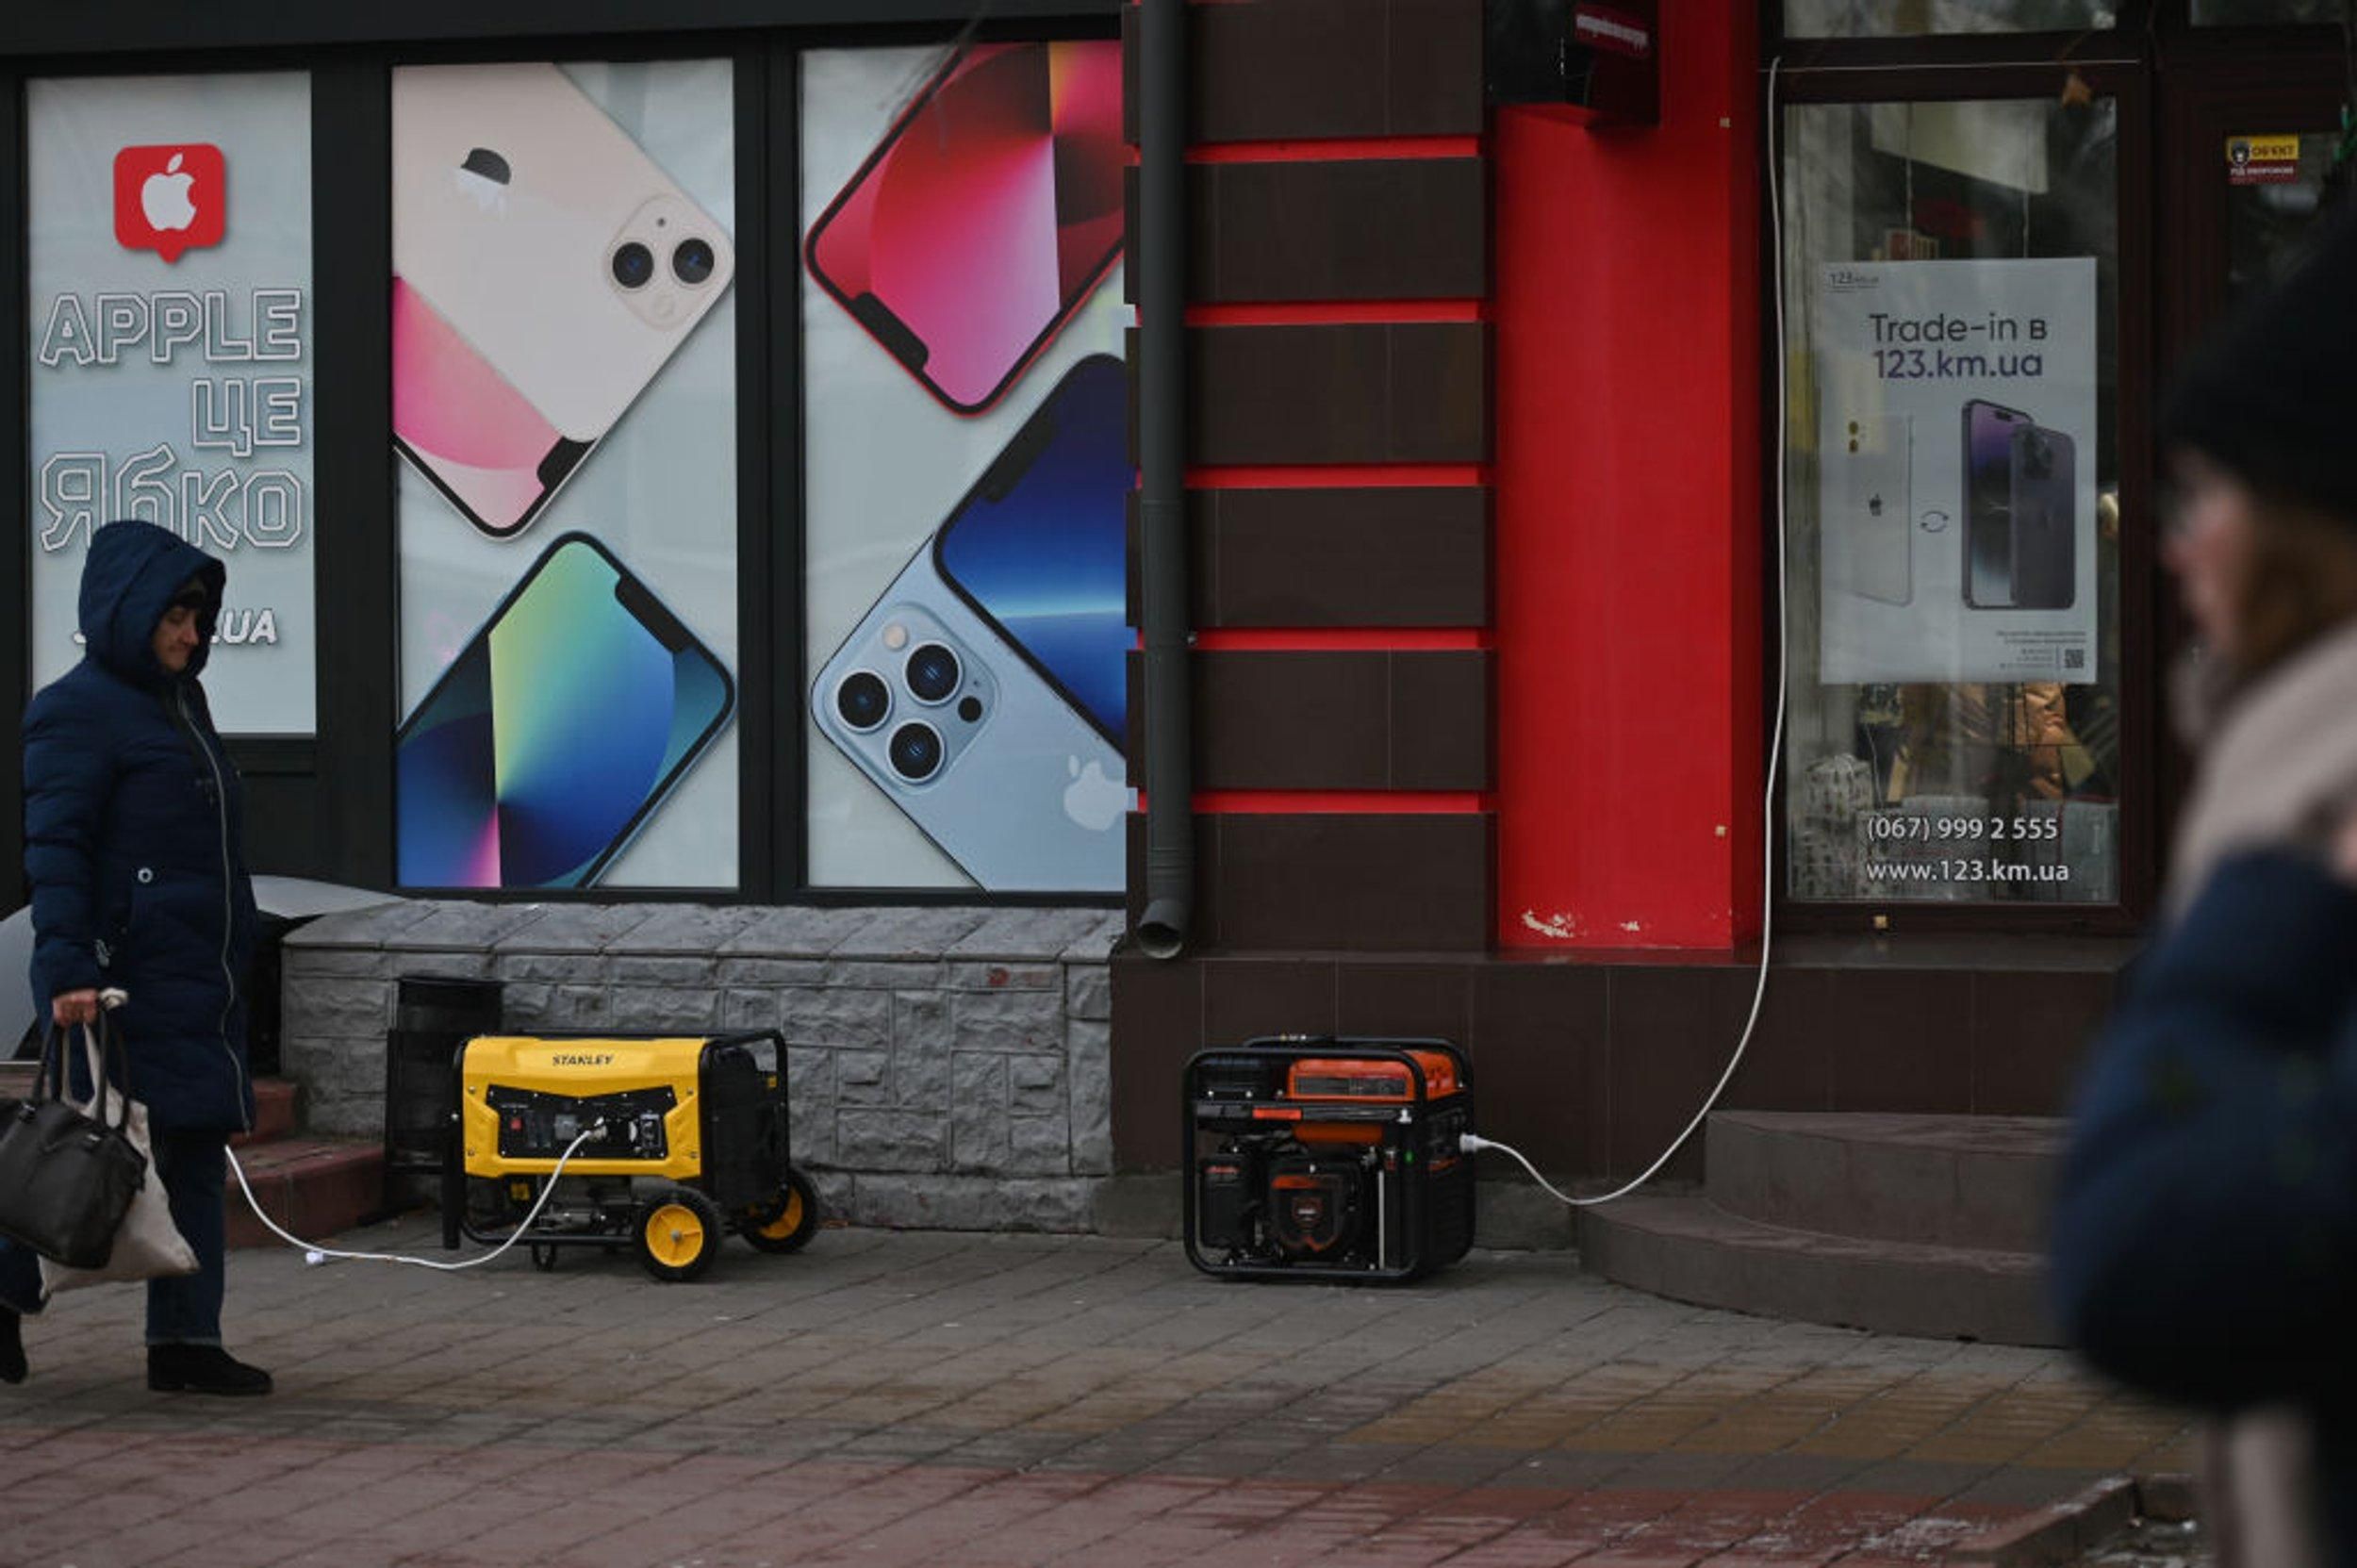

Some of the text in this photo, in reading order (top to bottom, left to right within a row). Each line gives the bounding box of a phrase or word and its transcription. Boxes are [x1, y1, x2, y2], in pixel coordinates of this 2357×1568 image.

[40, 289, 302, 366] APPLE
[1869, 312, 2019, 342] Trade-in
[1873, 349, 2043, 379] 123.km.ua
[192, 379, 302, 457] ЦЕ
[1868, 817, 2057, 841] (067) 999 2 555
[1867, 859, 2069, 882] www.123.km.ua
[552, 1054, 614, 1065] STANLEY
